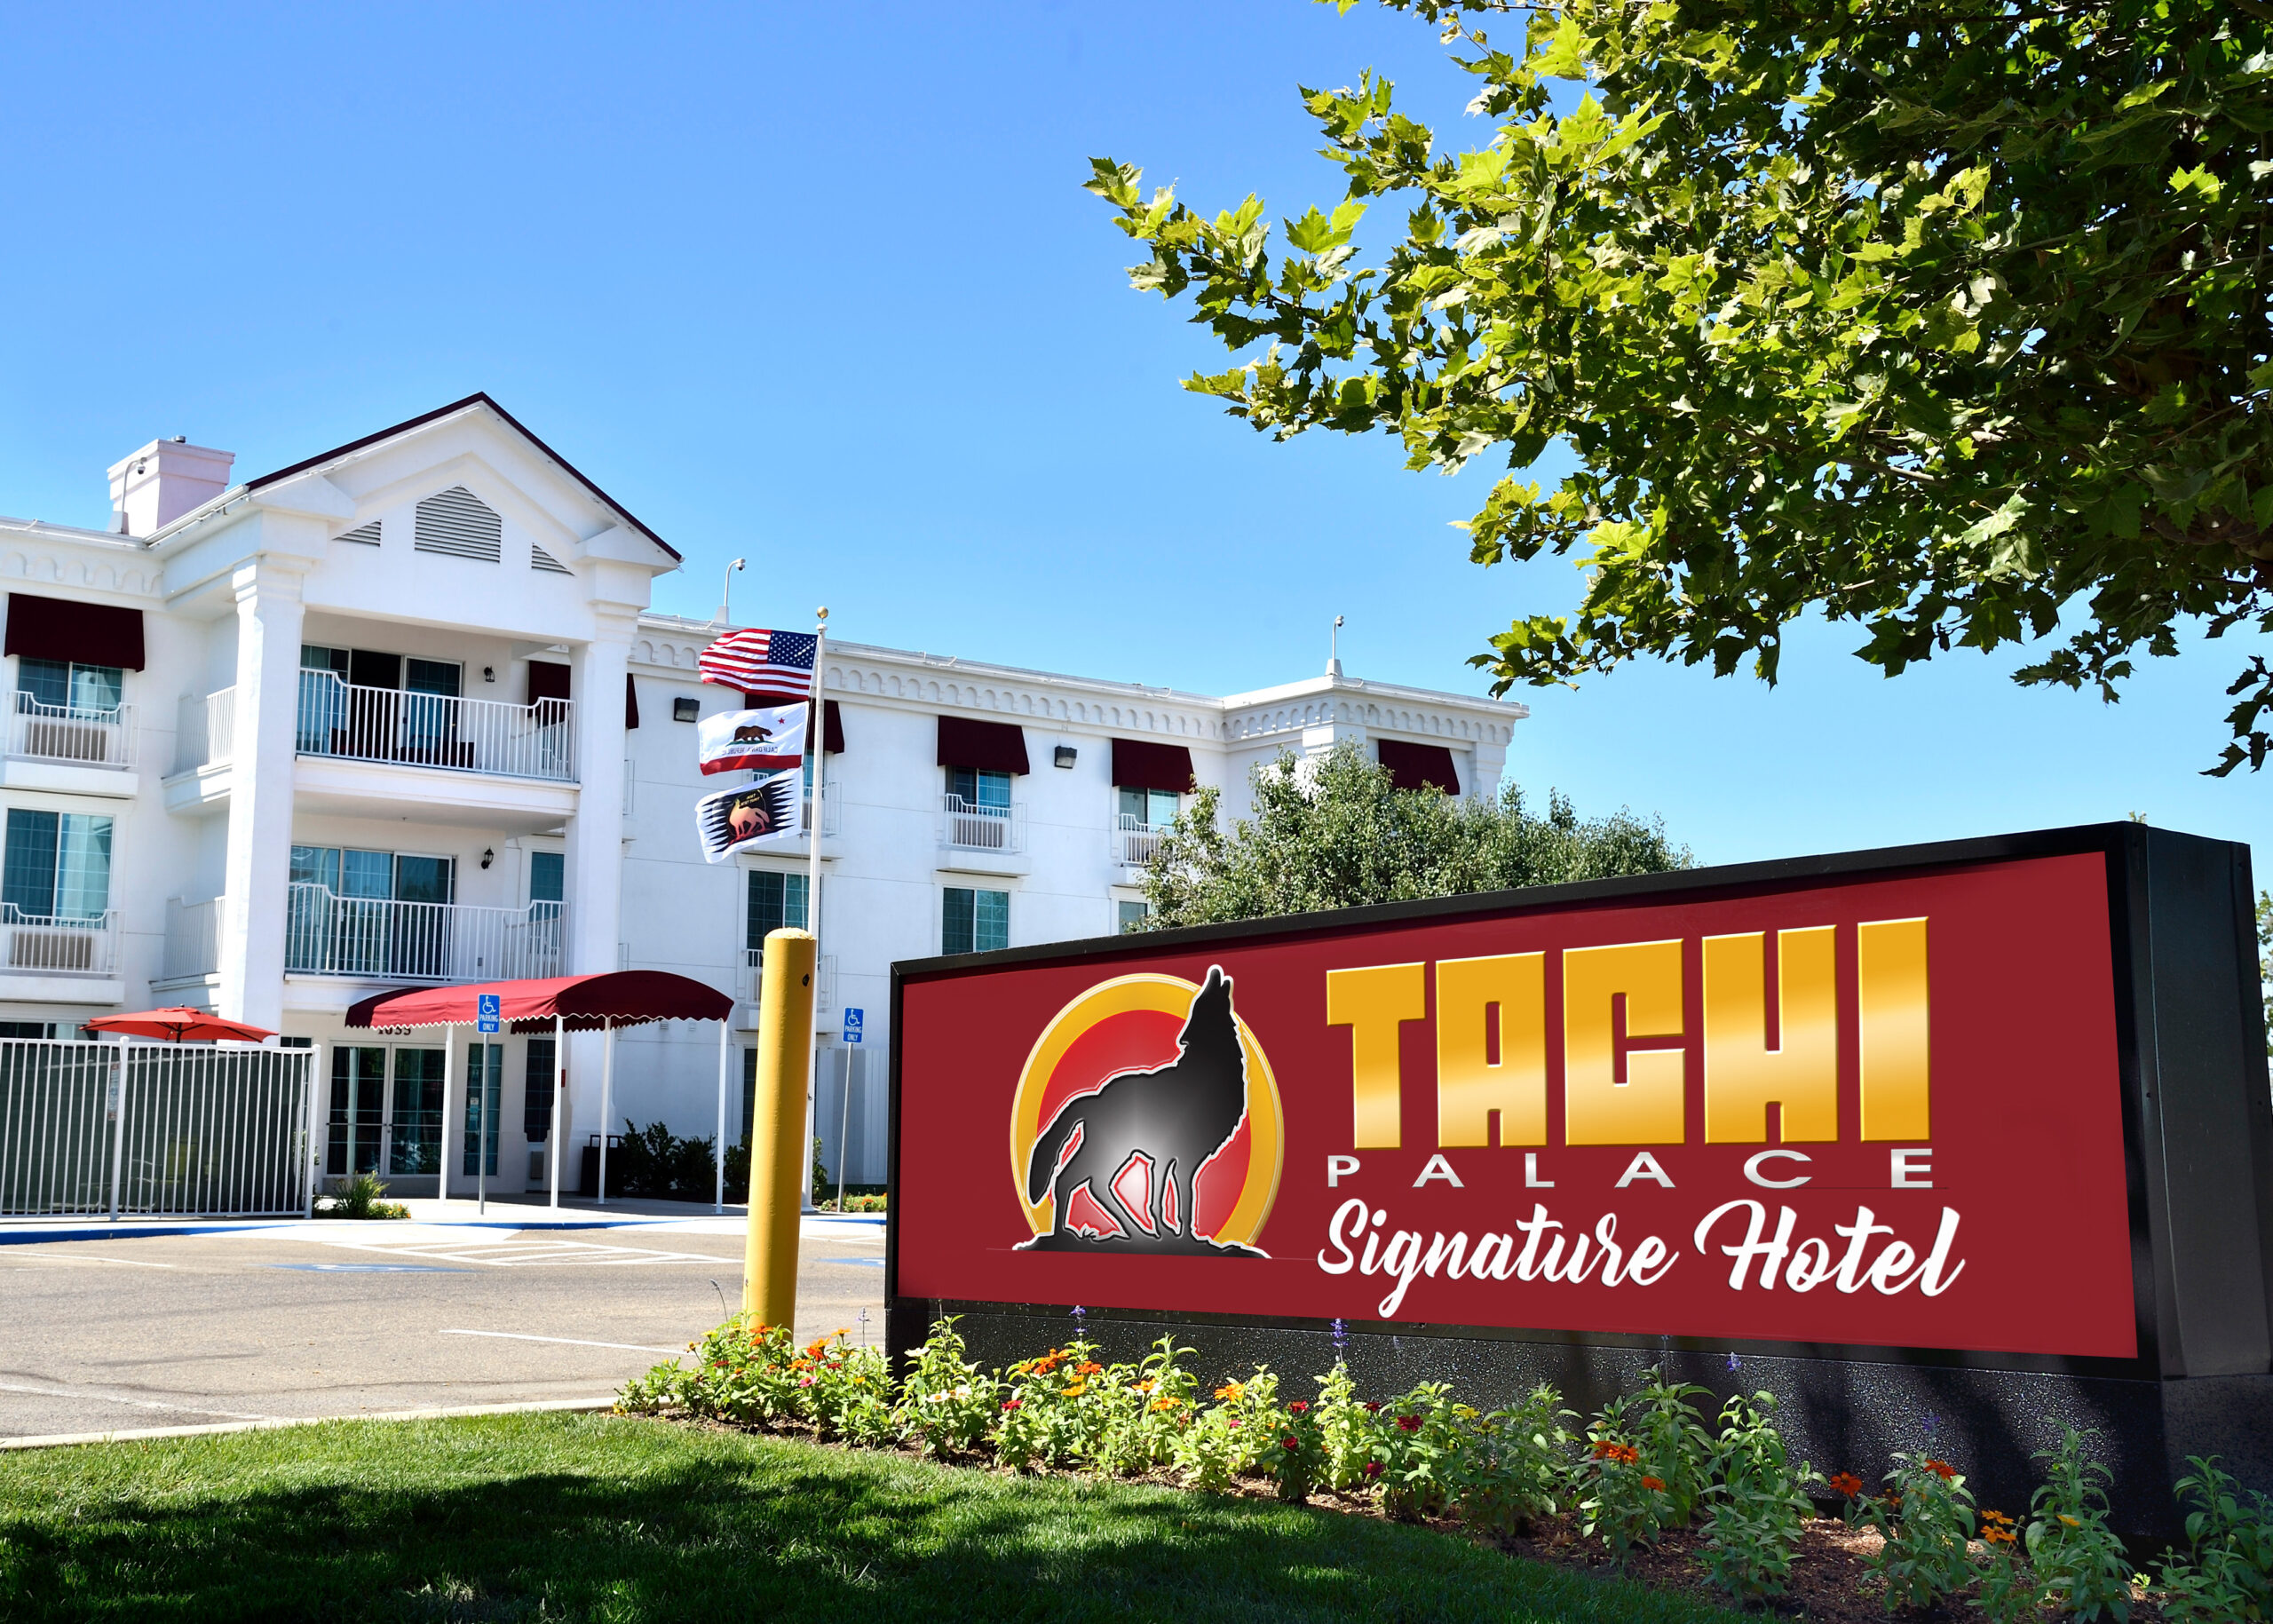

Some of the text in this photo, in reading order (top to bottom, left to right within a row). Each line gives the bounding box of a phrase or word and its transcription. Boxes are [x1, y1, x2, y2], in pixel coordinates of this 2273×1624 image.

[1327, 916, 1929, 1150] TACHI
[1327, 1149, 1933, 1189] PALACE
[1318, 1199, 1966, 1318] Signature Hotel
